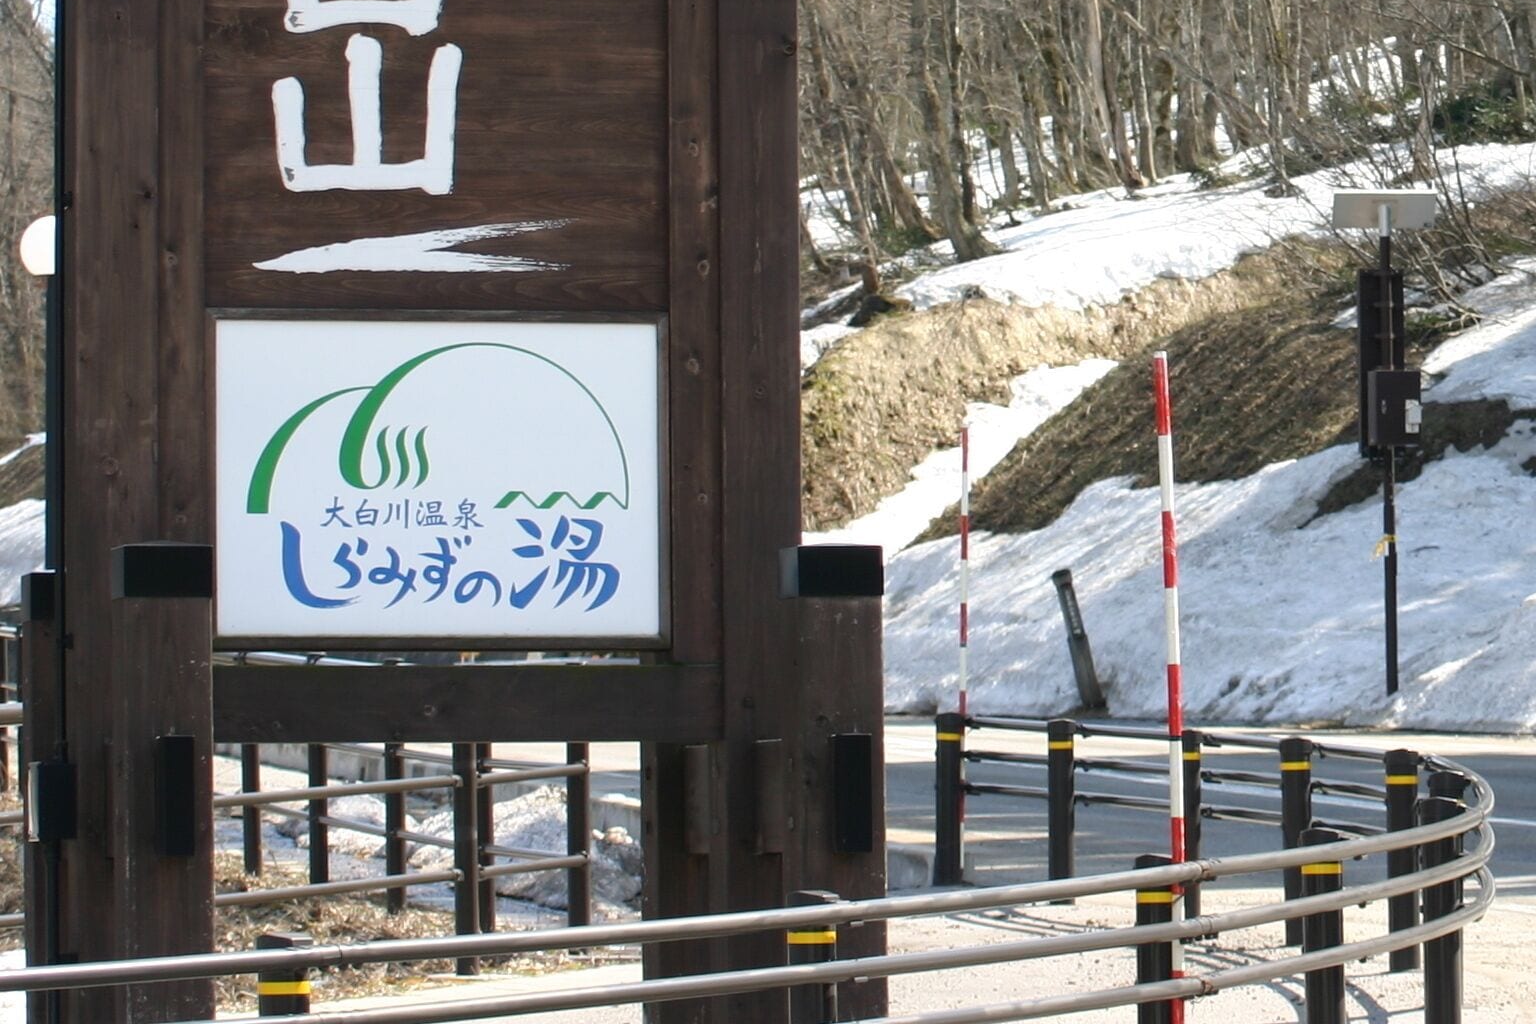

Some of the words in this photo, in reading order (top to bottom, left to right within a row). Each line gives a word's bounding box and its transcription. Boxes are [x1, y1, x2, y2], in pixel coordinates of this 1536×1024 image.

[319, 496, 485, 530] 大白川温泉
[279, 514, 621, 613] しらみずの湯
